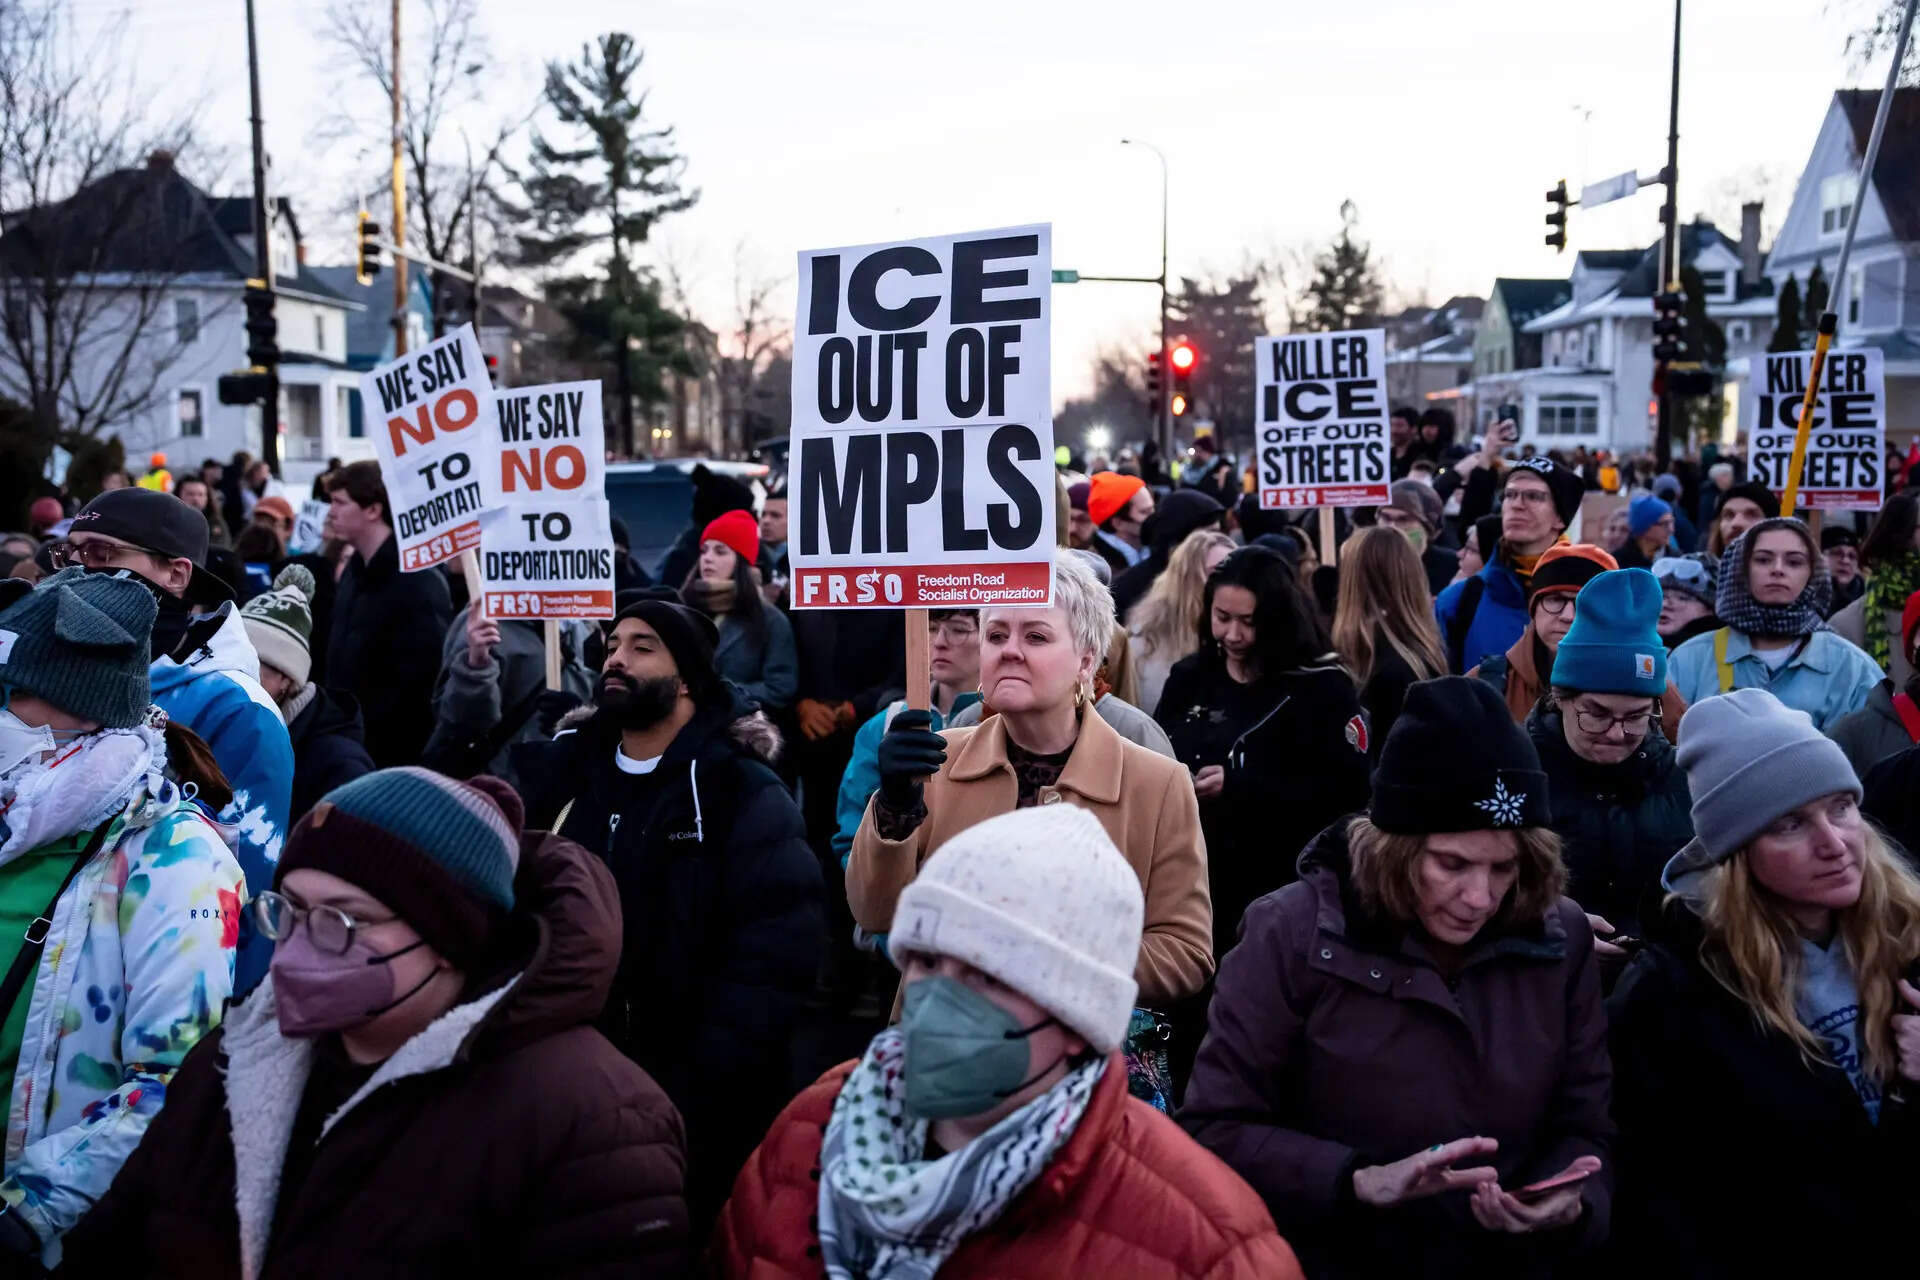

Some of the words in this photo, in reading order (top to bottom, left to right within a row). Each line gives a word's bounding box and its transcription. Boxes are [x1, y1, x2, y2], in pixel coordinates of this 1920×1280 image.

[808, 234, 1041, 335] ICE
[376, 363, 418, 414] WE
[417, 339, 467, 394] SAY
[818, 331, 928, 424] OUT
[945, 324, 1021, 419] OF
[1272, 336, 1368, 382] KILLER
[497, 396, 532, 442] WE
[537, 391, 583, 440] SAY
[1264, 380, 1382, 422] ICE
[1758, 394, 1877, 430] ICE
[387, 388, 478, 458] NO
[1263, 426, 1318, 443] OFF
[1323, 423, 1383, 440] OUR
[1756, 435, 1794, 449] OF
[1816, 434, 1877, 449] OUR
[417, 452, 471, 491] TO
[501, 444, 586, 493] NO
[1263, 441, 1384, 485] STREETS
[800, 424, 1043, 556] MPLS
[1265, 489, 1318, 506] FRSO
[521, 512, 572, 542] TO
[405, 534, 453, 569] FRSO
[486, 548, 611, 581] DEPORTATIONS
[803, 570, 903, 604] FRSO
[917, 575, 972, 588] Freedom
[973, 573, 1005, 586] Road
[918, 587, 967, 602] Socialist
[969, 586, 1045, 602] Organization
[487, 593, 540, 614] FRSO
[190, 909, 229, 920] ROXY
